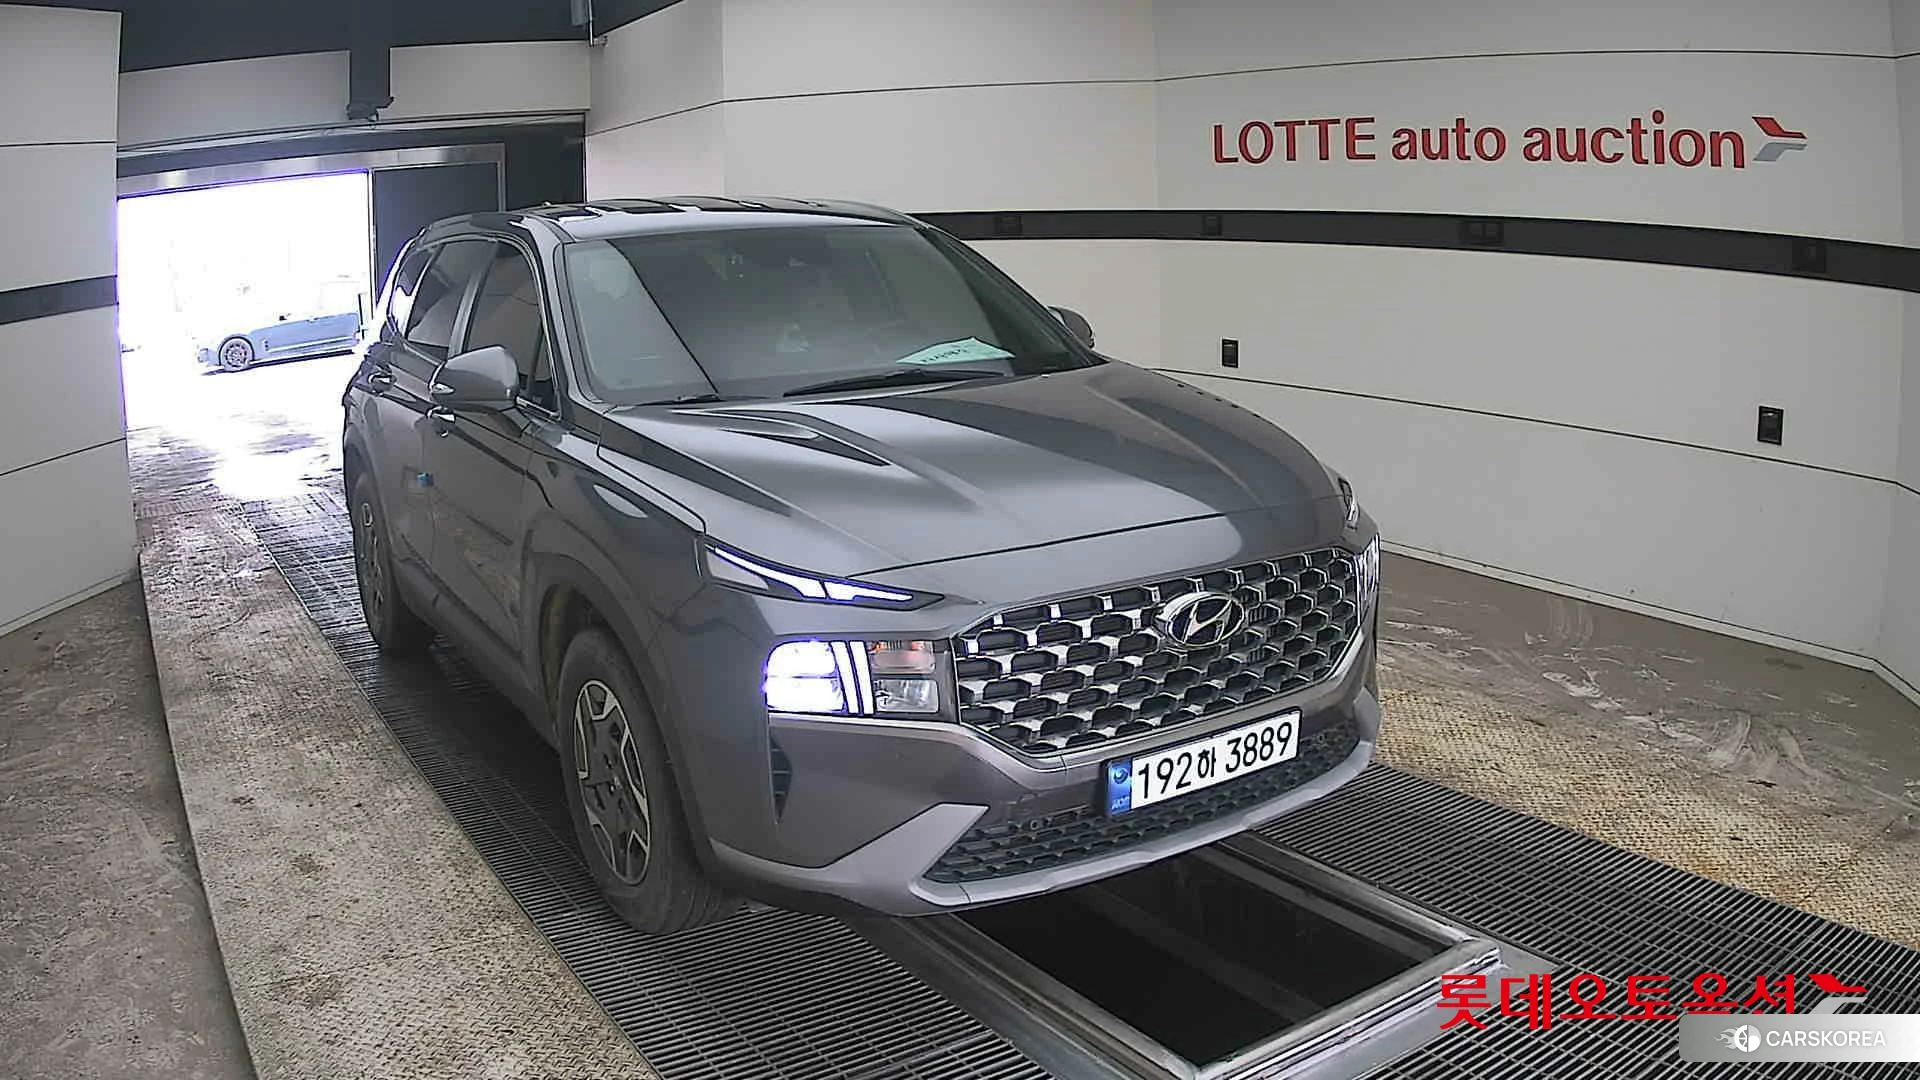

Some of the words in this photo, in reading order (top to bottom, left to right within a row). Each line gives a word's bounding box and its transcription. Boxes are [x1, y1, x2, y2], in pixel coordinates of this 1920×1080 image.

[1213, 116, 1376, 164] LOTTE
[1392, 117, 1506, 162] auto
[1522, 110, 1745, 169] auction
[1138, 747, 1217, 799] 192하
[1226, 722, 1293, 773] 3889
